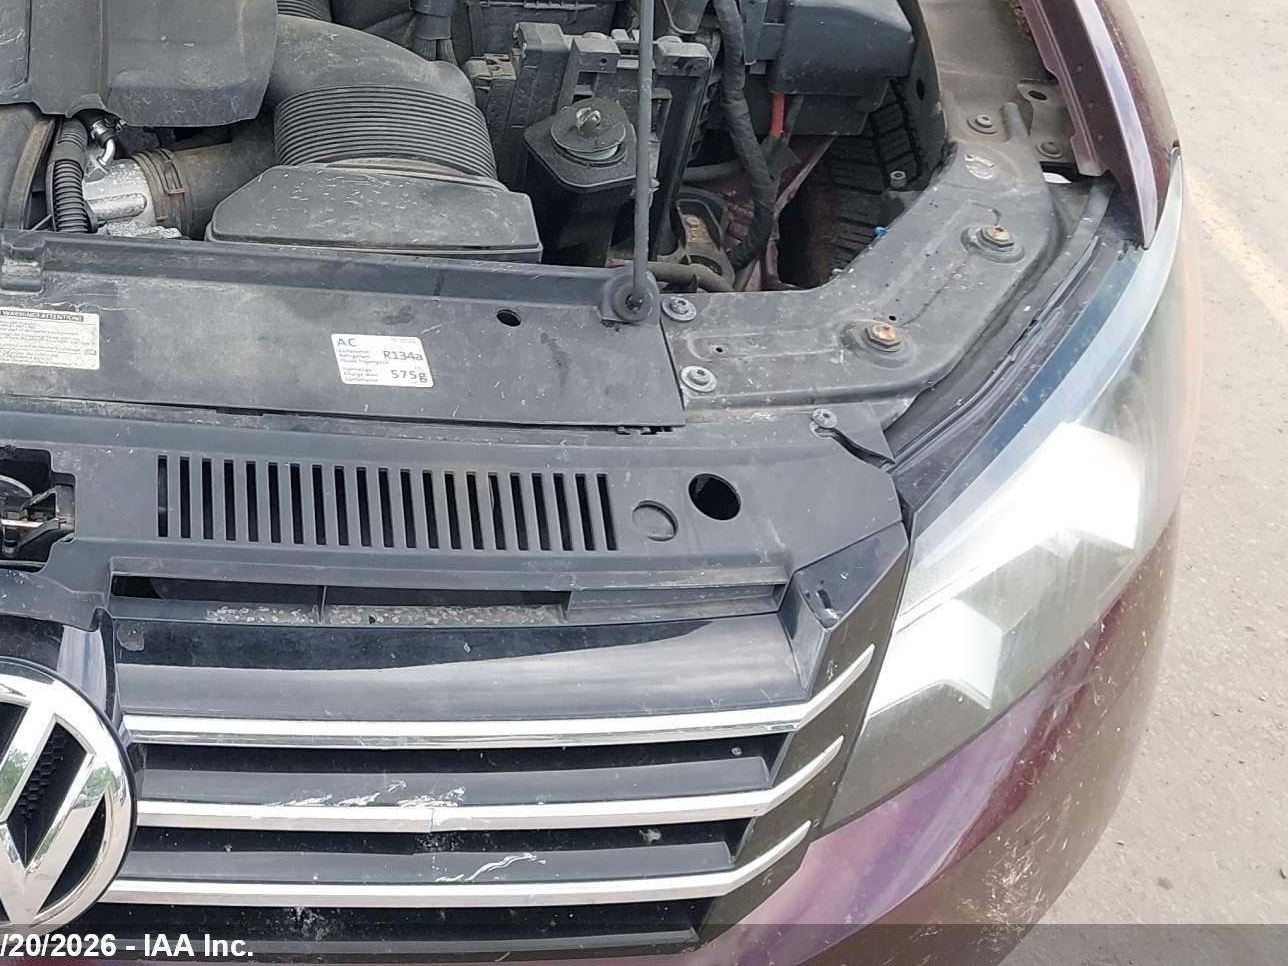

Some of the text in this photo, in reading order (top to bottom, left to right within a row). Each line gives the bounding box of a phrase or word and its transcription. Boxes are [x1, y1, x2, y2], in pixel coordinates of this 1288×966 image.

[337, 338, 357, 347] AC
[383, 350, 423, 361] R134a
[390, 369, 428, 383] 575g
